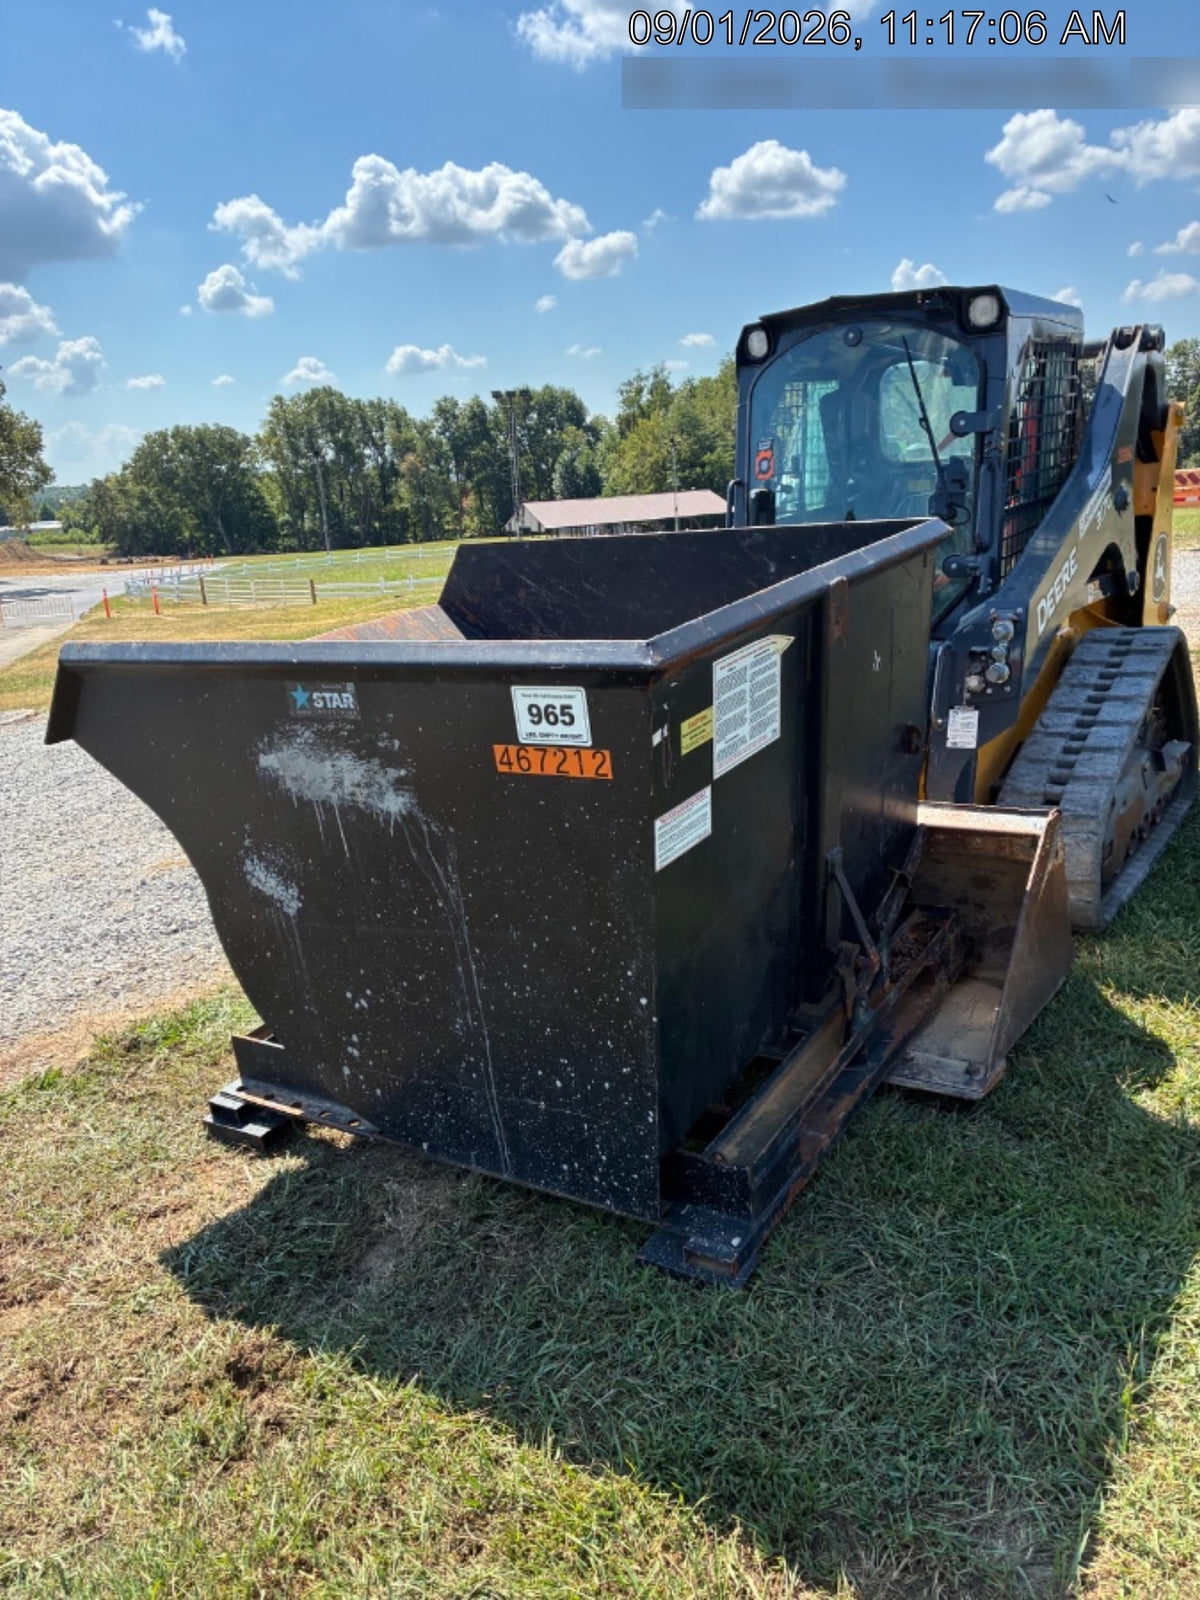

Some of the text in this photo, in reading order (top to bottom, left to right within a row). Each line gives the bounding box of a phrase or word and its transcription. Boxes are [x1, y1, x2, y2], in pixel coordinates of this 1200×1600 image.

[1036, 546, 1079, 637] DEERE
[312, 692, 355, 710] STAR
[527, 703, 575, 727] 965
[498, 745, 609, 778] 467212
